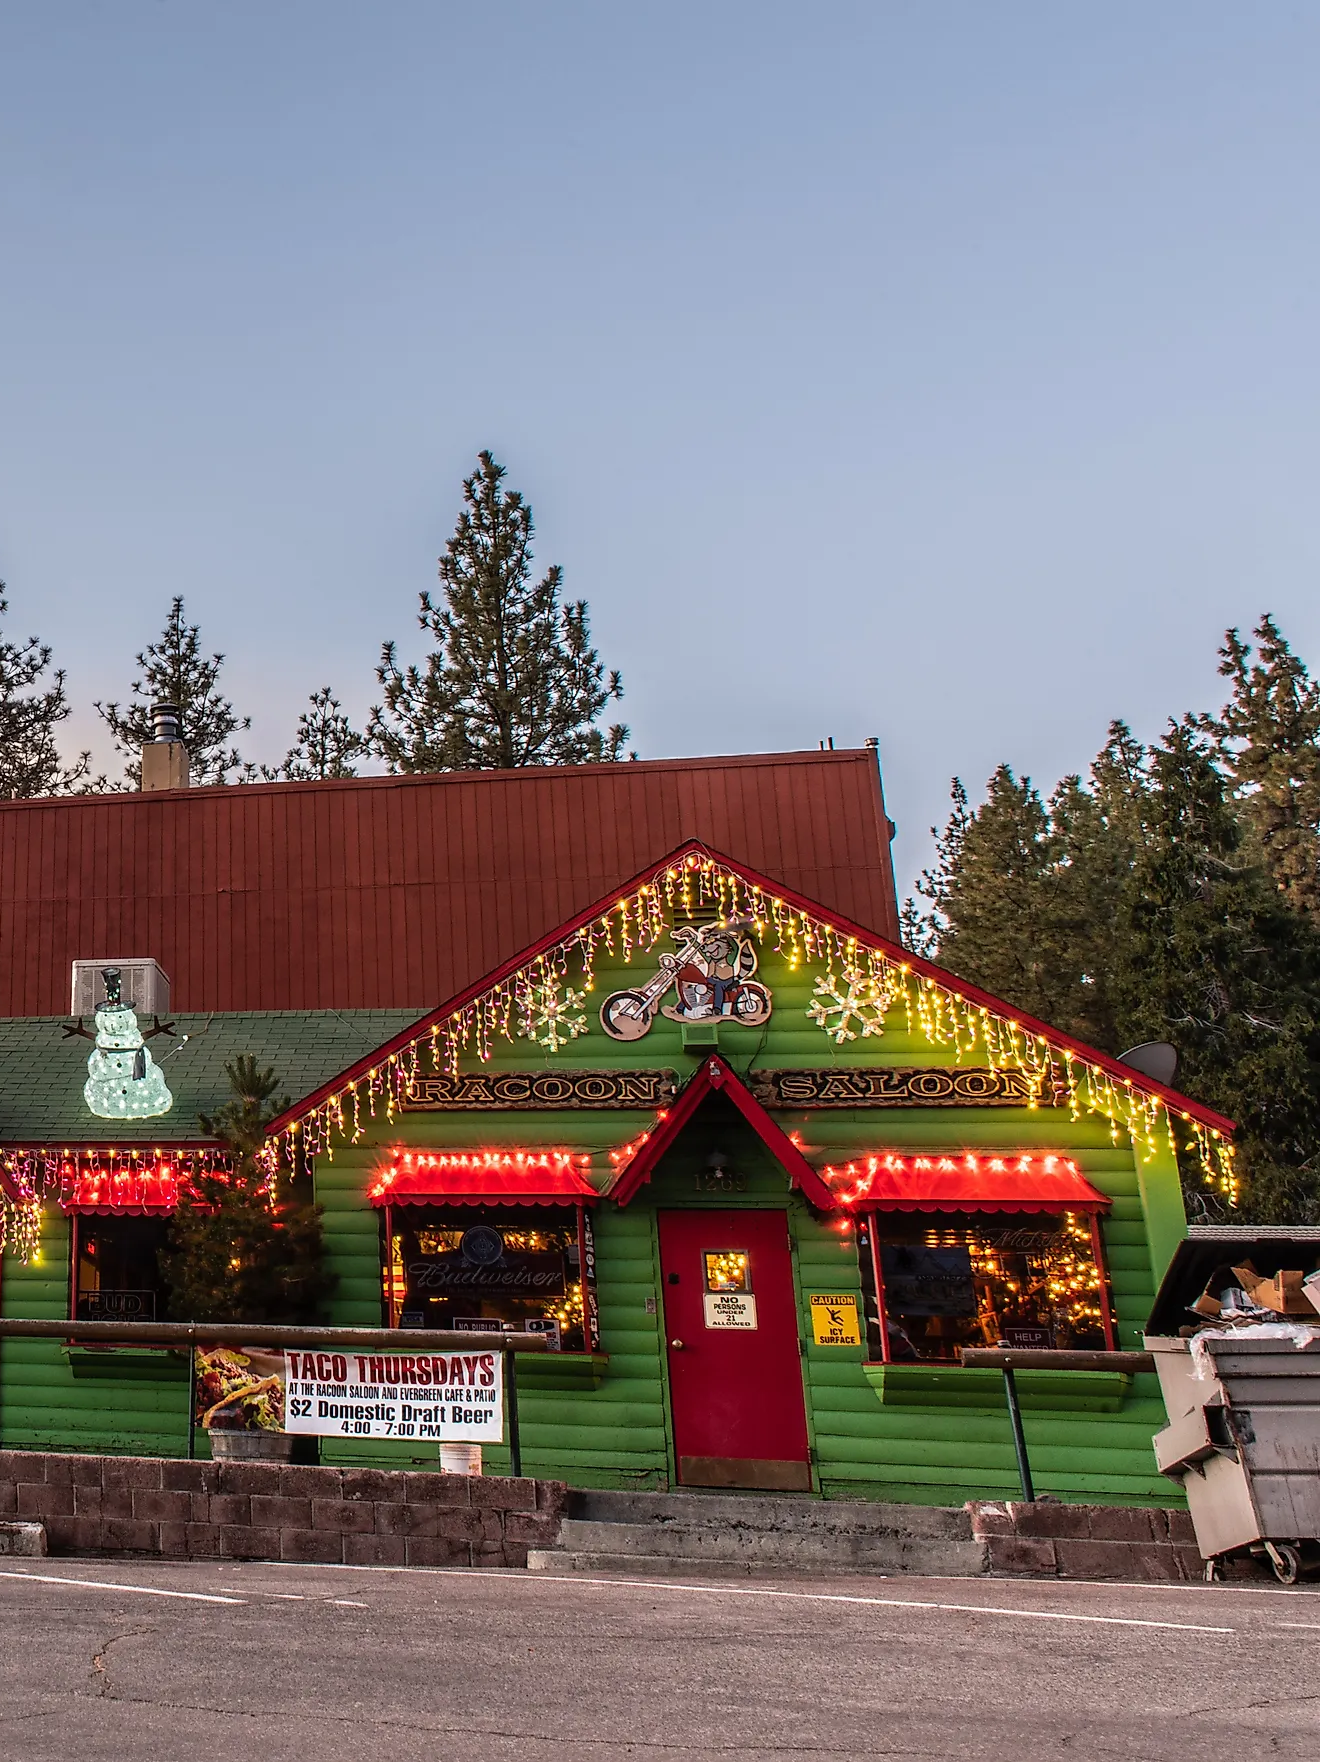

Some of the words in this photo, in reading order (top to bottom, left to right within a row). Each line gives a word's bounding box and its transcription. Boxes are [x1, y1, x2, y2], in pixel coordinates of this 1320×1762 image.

[412, 1077, 660, 1101] RACOON
[779, 1073, 1044, 1099] SALOON
[408, 1263, 562, 1287] Budweiser
[89, 1293, 142, 1313] BUD
[811, 1296, 854, 1304] CAUTION
[458, 1322, 468, 1331] NO
[472, 1322, 497, 1332] PUBLIC
[820, 1336, 856, 1344] SURFACE
[1015, 1333, 1042, 1342] HELP
[287, 1352, 348, 1382] TACO
[354, 1354, 495, 1386] THURSDAYS
[289, 1382, 299, 1396] AT
[300, 1382, 314, 1396] THE
[316, 1383, 347, 1398] RACOON
[349, 1385, 380, 1400] SALOON
[382, 1386, 398, 1400] AND
[400, 1387, 442, 1402] EVERGREEN
[444, 1388, 463, 1402] CAFE
[465, 1390, 472, 1403] &
[474, 1389, 496, 1403] PATIO
[290, 1397, 312, 1419] $2
[318, 1400, 396, 1422] Domestic
[401, 1403, 446, 1423] Draft
[452, 1405, 493, 1424] Beer
[340, 1420, 371, 1434] 4:00
[384, 1422, 415, 1436] 7:00
[419, 1424, 441, 1437] PM
